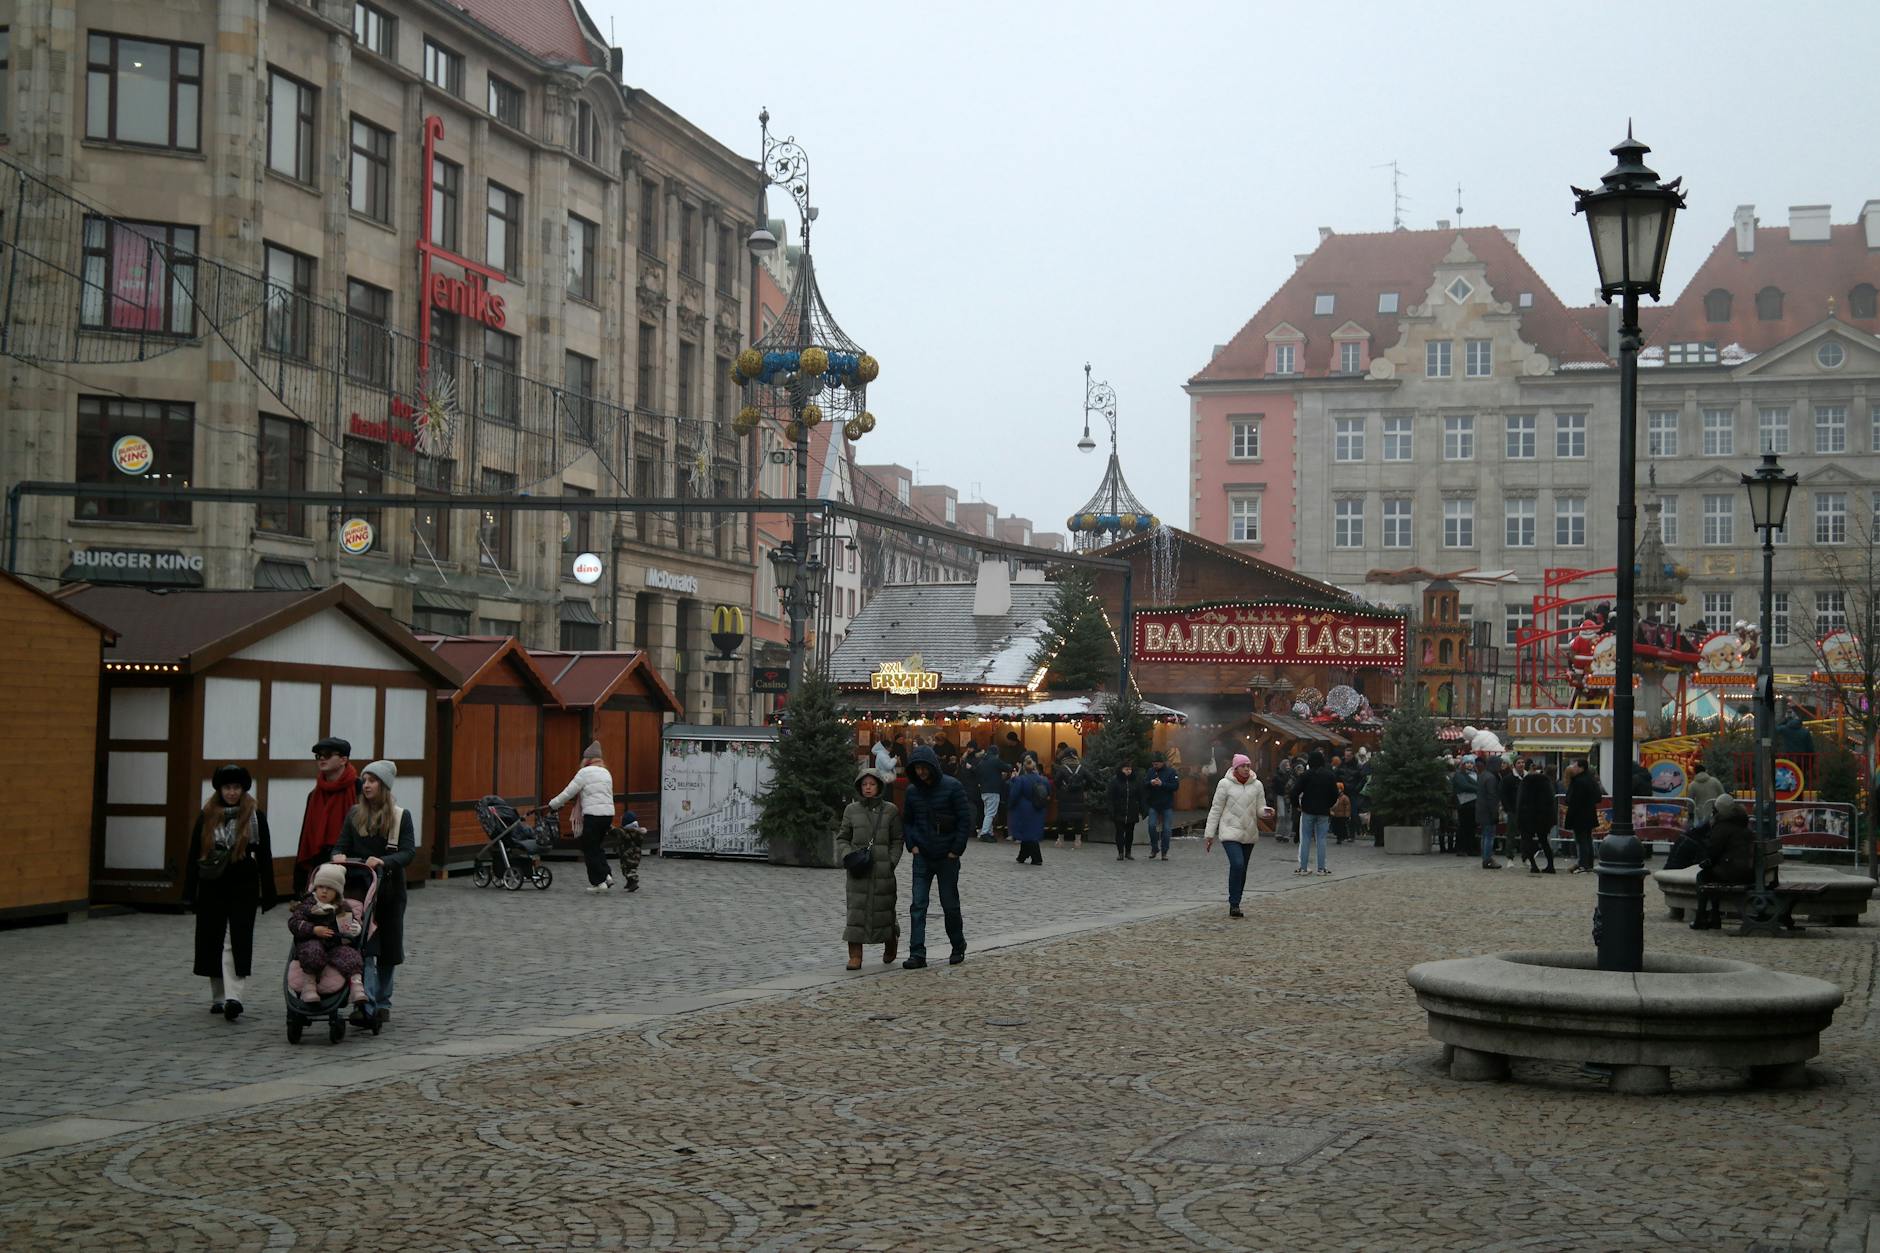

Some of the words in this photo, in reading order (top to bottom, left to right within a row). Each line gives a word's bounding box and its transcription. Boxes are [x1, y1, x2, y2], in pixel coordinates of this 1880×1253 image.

[118, 443, 147, 456] BURGER
[119, 450, 148, 464] KING
[345, 532, 369, 545] KING
[72, 550, 151, 568] BURGER
[155, 553, 204, 571] KING
[576, 564, 599, 574] dino
[645, 567, 698, 594] McDonald's
[1144, 623, 1291, 655] BAJKOWY
[1296, 624, 1398, 656] LASEK
[880, 661, 904, 674] XXL
[755, 679, 788, 689] Casino
[871, 672, 938, 690] FRYTKI
[1511, 716, 1602, 735] TICKETS
